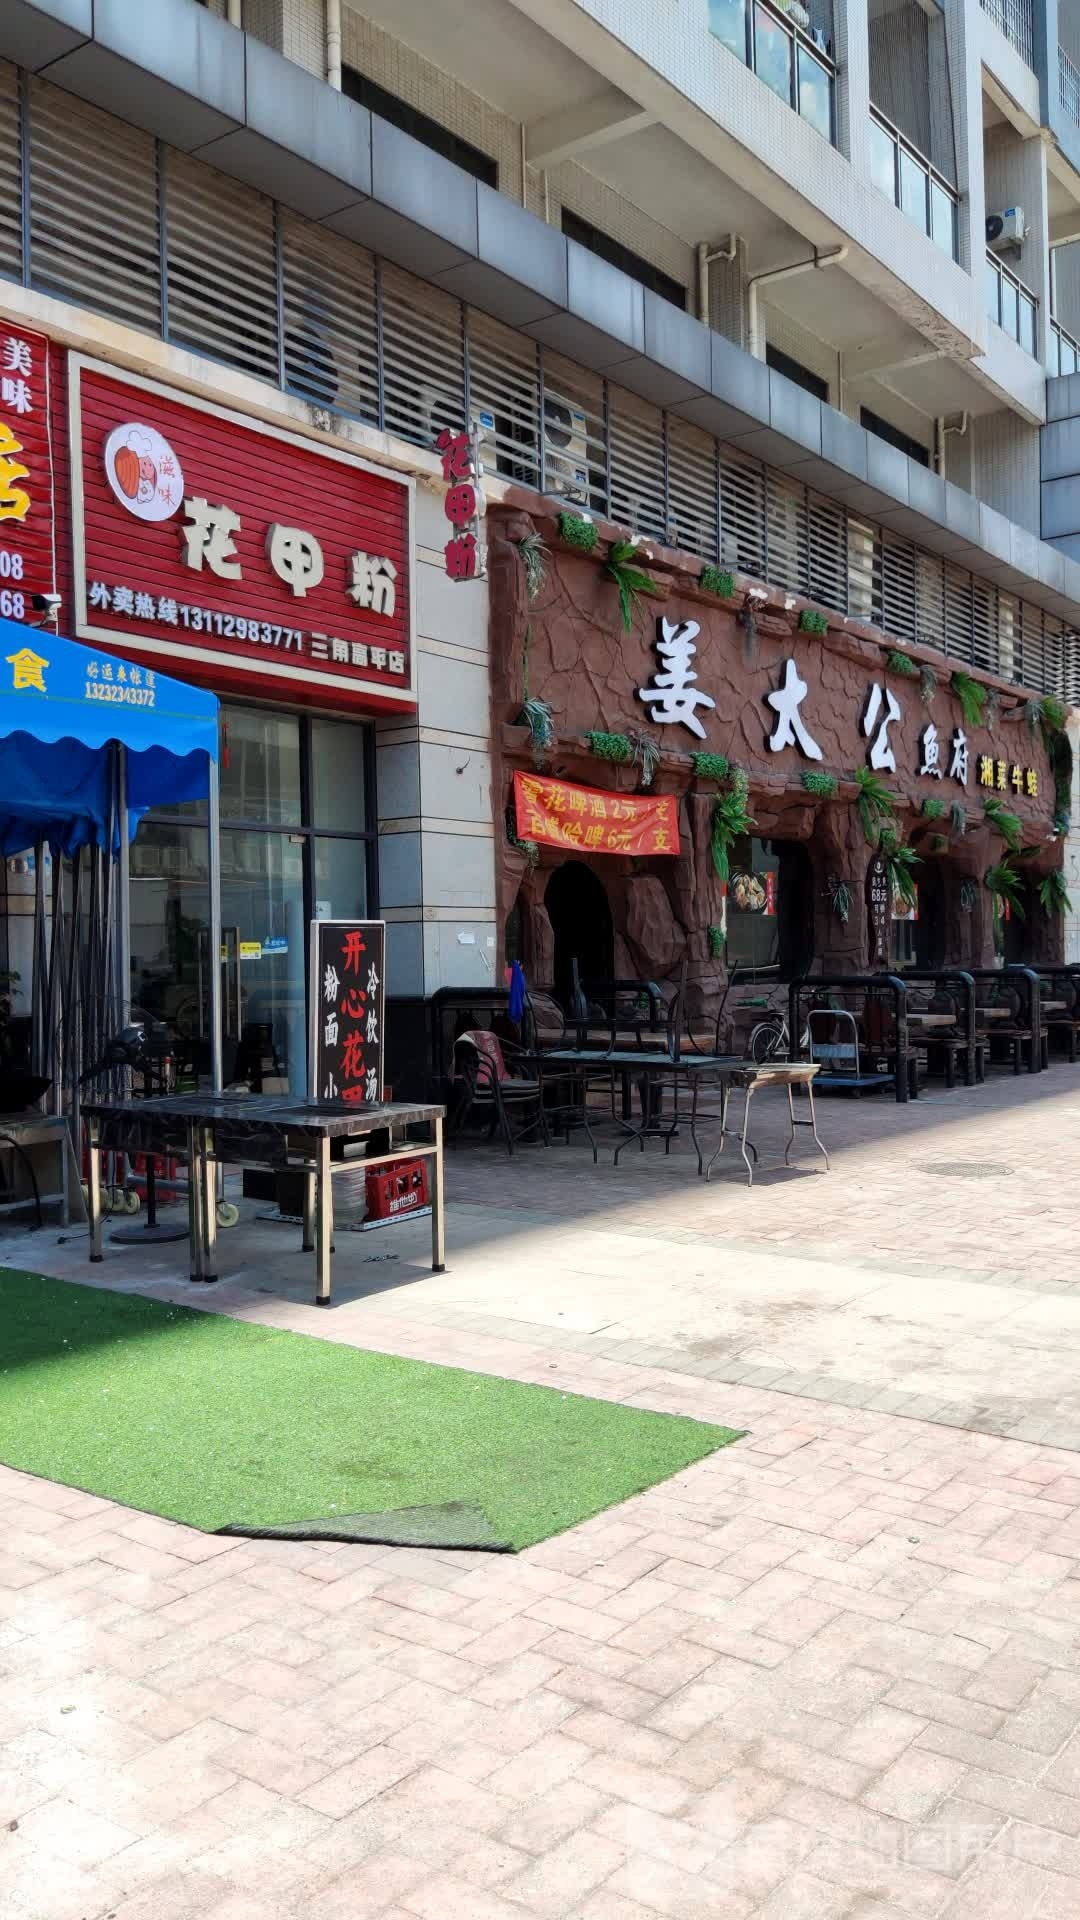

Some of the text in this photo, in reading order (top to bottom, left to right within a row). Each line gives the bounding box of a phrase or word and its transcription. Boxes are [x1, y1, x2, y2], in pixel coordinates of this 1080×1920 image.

[1, 337, 34, 413] 美味
[435, 428, 477, 579] 花甲粉
[181, 497, 398, 617] 花甲粉
[5, 647, 50, 692] 食
[85, 682, 155, 707] 13232343372
[980, 755, 1038, 797] 湘菜牛蛙
